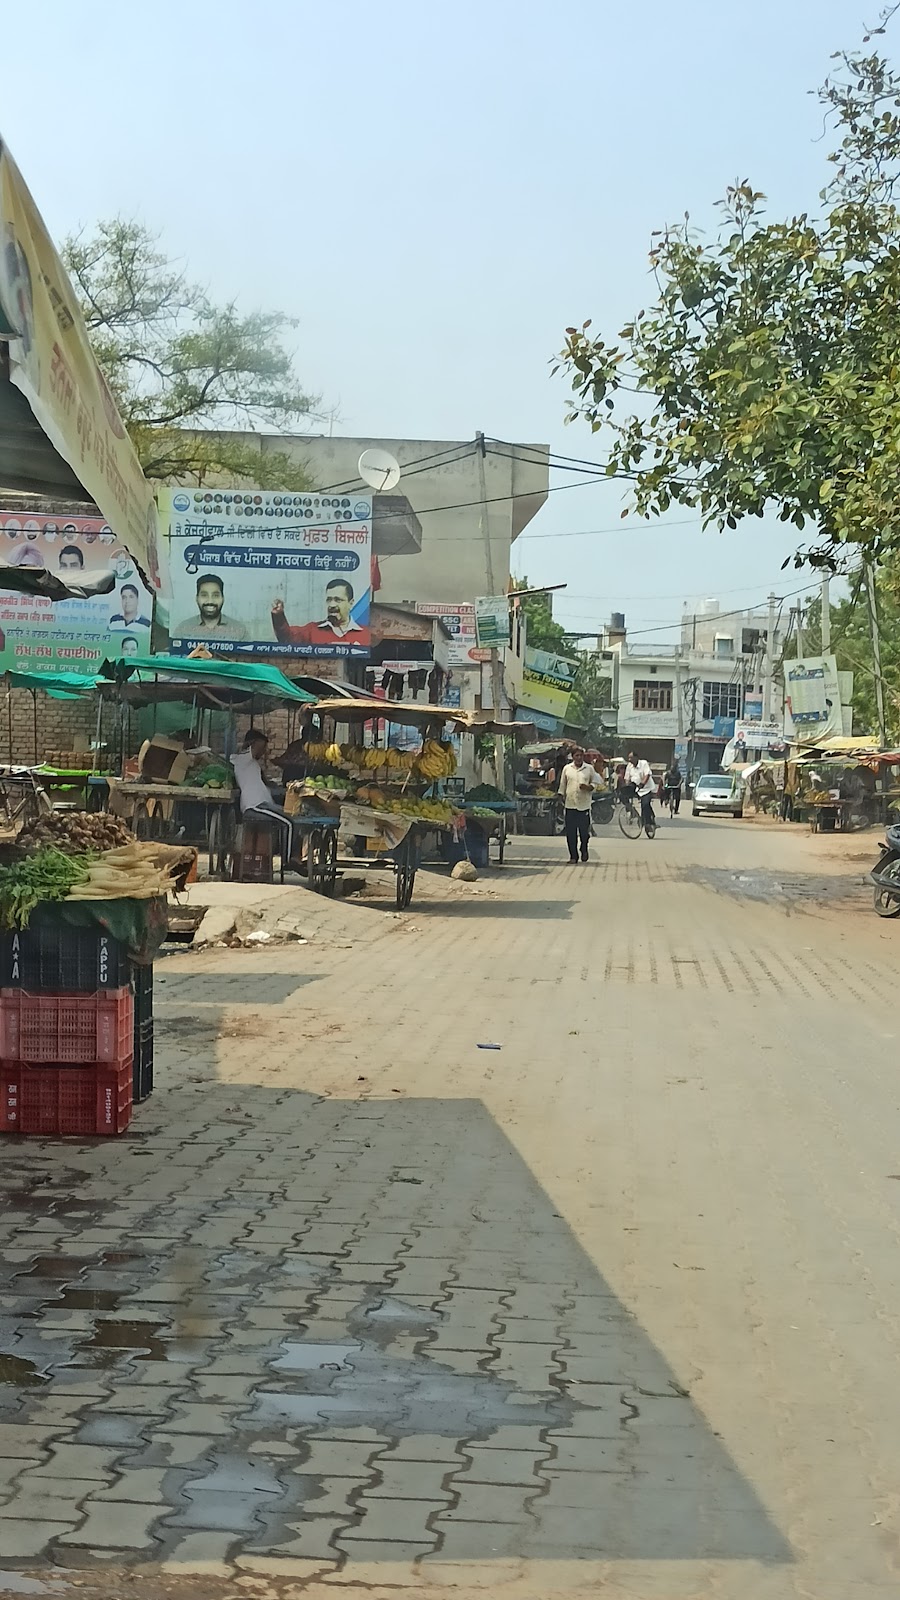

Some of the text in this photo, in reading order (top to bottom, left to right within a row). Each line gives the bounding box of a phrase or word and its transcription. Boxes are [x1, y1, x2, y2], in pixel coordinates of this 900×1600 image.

[184, 518, 225, 538] ਕੇਜਰੀਵਾਲ
[302, 528, 330, 546] ਮੁਫ਼ਤ
[334, 524, 369, 544] ਬਿਜਲੀ
[199, 549, 222, 563] ਪੰਜਾਬ
[223, 550, 242, 563] ਵਿੱਚ
[243, 547, 273, 565] ਪੰਜਾਬ
[275, 552, 313, 567] ਸਰਕਾਰ
[314, 554, 333, 570] ਕਿਉਂ
[418, 604, 459, 614] COMPETITION
[459, 605, 475, 614] CLAS
[15, 643, 53, 657] ਲੱਖ-ਲੱਖ
[100, 938, 108, 983] PAPPU
